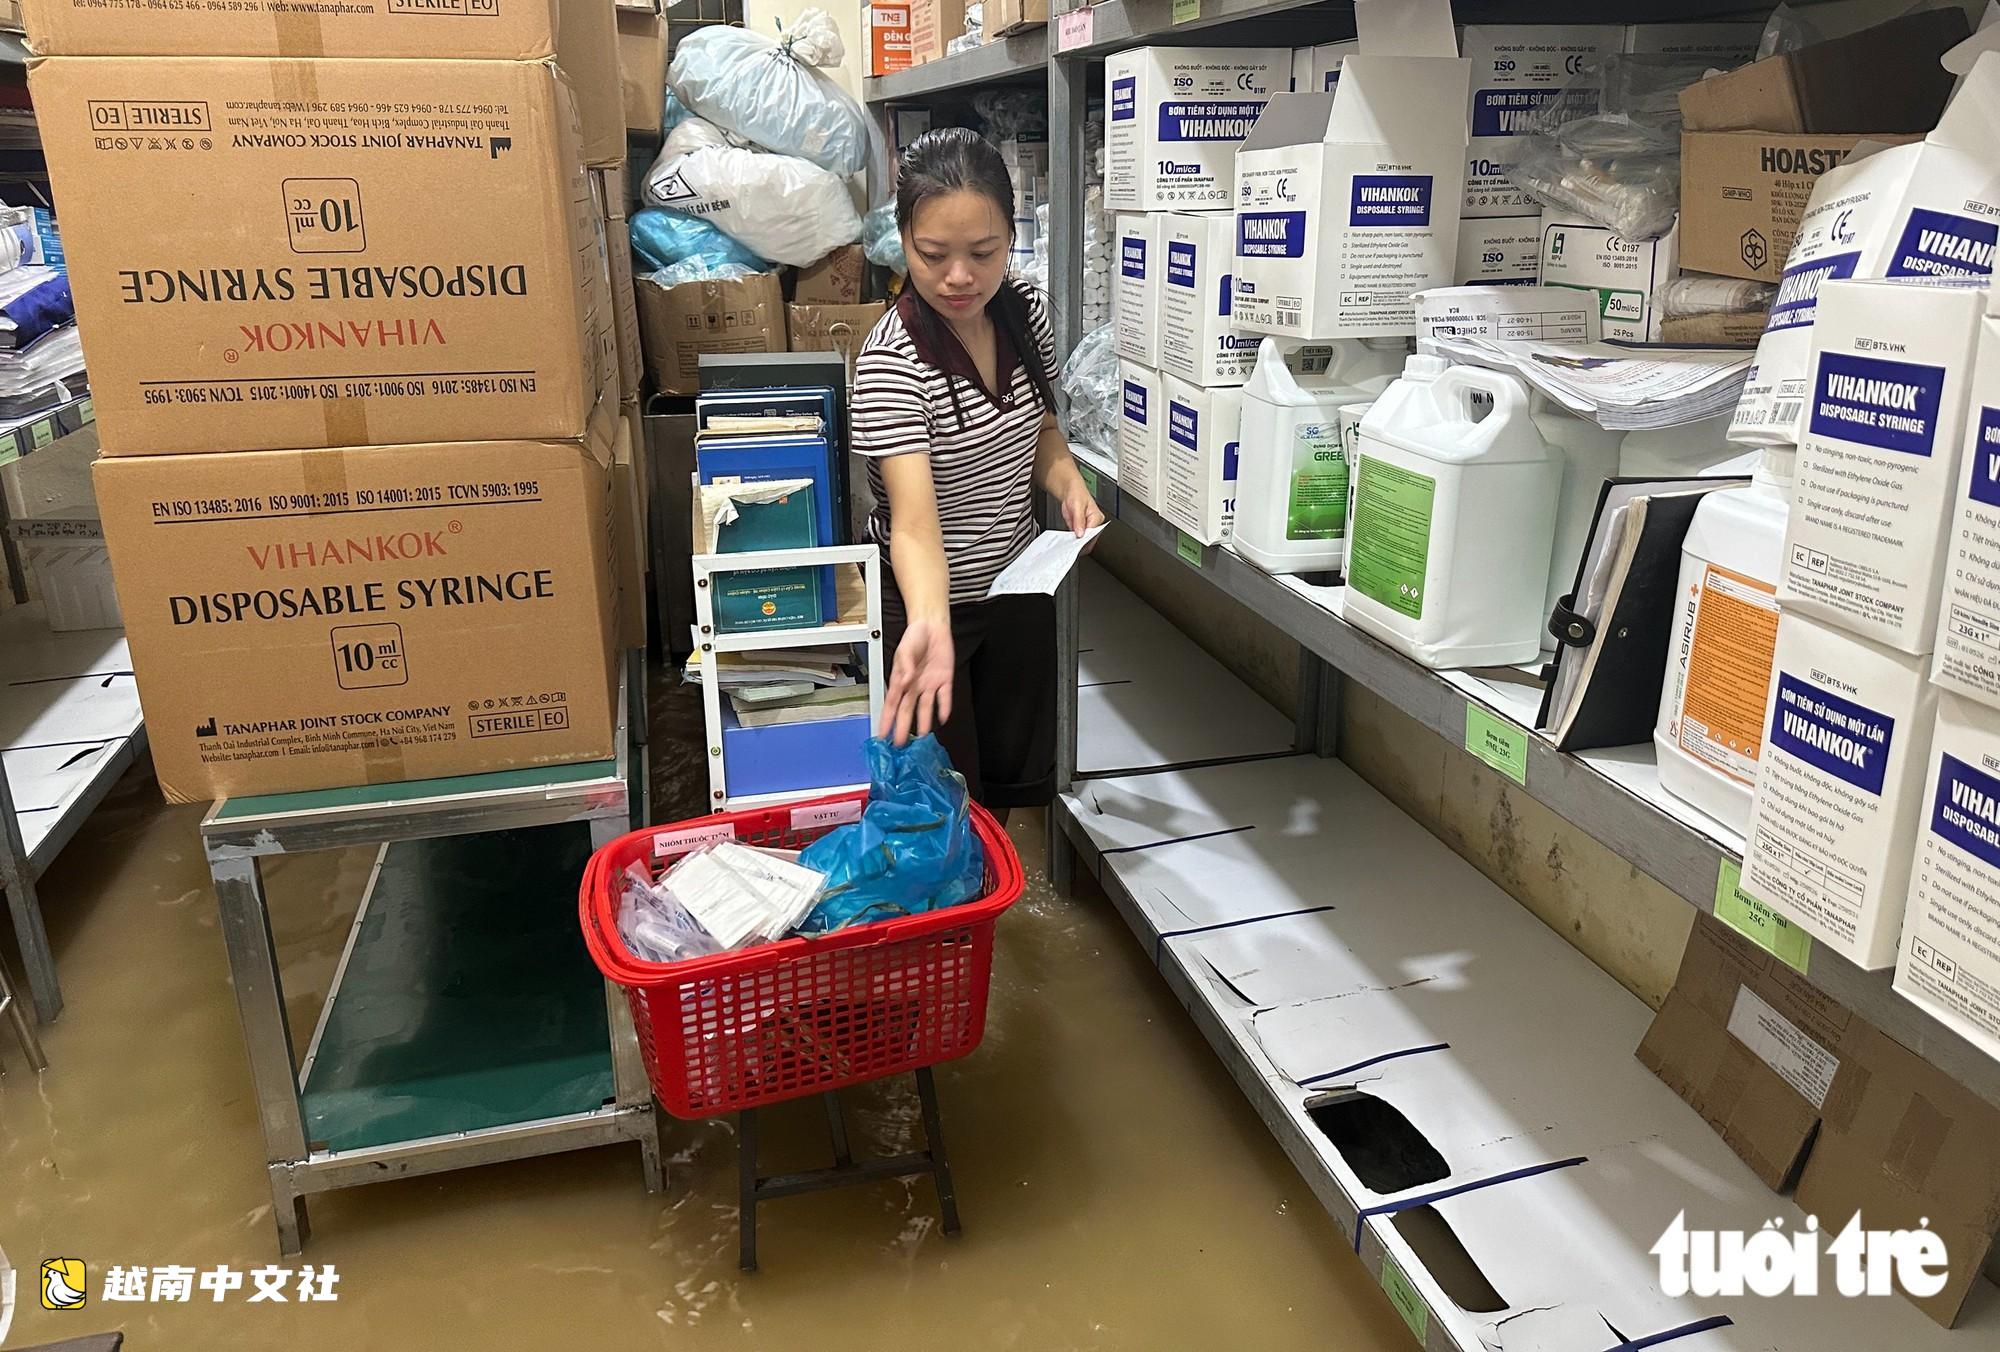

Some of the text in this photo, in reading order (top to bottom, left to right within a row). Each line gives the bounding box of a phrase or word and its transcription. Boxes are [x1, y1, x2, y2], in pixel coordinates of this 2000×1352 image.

[291, 3, 374, 16] www.tanaphar.com
[1493, 60, 1516, 71] ISO
[1173, 77, 1194, 87] ISO
[226, 100, 509, 115] Tel: 0964 775 178 0964 625 466 0964 589 296 Web: tanaphar.com
[1486, 94, 1506, 106] BƠM
[1508, 92, 1528, 107] TIÊM
[95, 107, 202, 125] STERILE EO
[1168, 104, 1185, 116] BƠM
[1187, 104, 1205, 116] TIÊM
[1206, 103, 1217, 116] SỬ
[1180, 119, 1254, 138] VIHANKOK
[231, 133, 483, 149] TANAPHAR JOINT STOCK COMPANY
[1361, 187, 1420, 202] VIHANKOK
[293, 198, 311, 211] cc
[1356, 205, 1425, 215] DISPOSABLE SYRINGE
[320, 198, 360, 233] 10
[1244, 218, 1287, 240] VIHANKOK
[1622, 244, 1640, 253] 0197
[118, 265, 528, 303] DISPOSABLE SYRINGE
[1613, 328, 1634, 338] 25 Pcs
[1856, 340, 1870, 348] REF
[144, 378, 536, 404] EN ISO 13485: 2016 ISO 9001: 2015 ISO 14001: 2015 TCVN 5903: 1995
[1828, 373, 1919, 411] VIHANKOK
[1819, 402, 1925, 435] DISPOSABLE SYRINGE
[1306, 426, 1319, 435] SG
[1314, 451, 1343, 462] GREE
[1847, 470, 1872, 485] Ethylene
[1872, 477, 1889, 488] Oxide
[1890, 480, 1903, 490] Gas
[152, 481, 539, 517] EN ISO 13485: 2016 ISO 9001: 2015 ISO 14001: 2015 TCVN 5903: 1995
[1840, 488, 1870, 504] packaging
[1876, 498, 1909, 512] punctured
[1796, 551, 1825, 568] EC REP
[169, 569, 555, 626] DISPOSABLE SYRINGE
[1679, 601, 1696, 669] ASIRUB
[337, 640, 396, 674] 10 ml
[382, 658, 399, 671] cc
[1812, 671, 1824, 681] REF
[223, 706, 451, 735] TANAPHAR JOINT STOCK COMPANY
[1781, 687, 1797, 705] BƠM
[1796, 695, 1813, 713] TIÊM
[1814, 702, 1825, 719] SỬ
[1825, 709, 1846, 728] DỤNG
[1847, 718, 1866, 736] MỘT
[476, 711, 564, 734] STERILE EO
[1783, 709, 1867, 768] VIHANKOK
[1943, 805, 2000, 848] DISPOSABL
[1733, 888, 1788, 929] Bơm tiêm 5ml
[1748, 911, 1765, 928] 25G
[1917, 945, 1953, 973] EC REP
